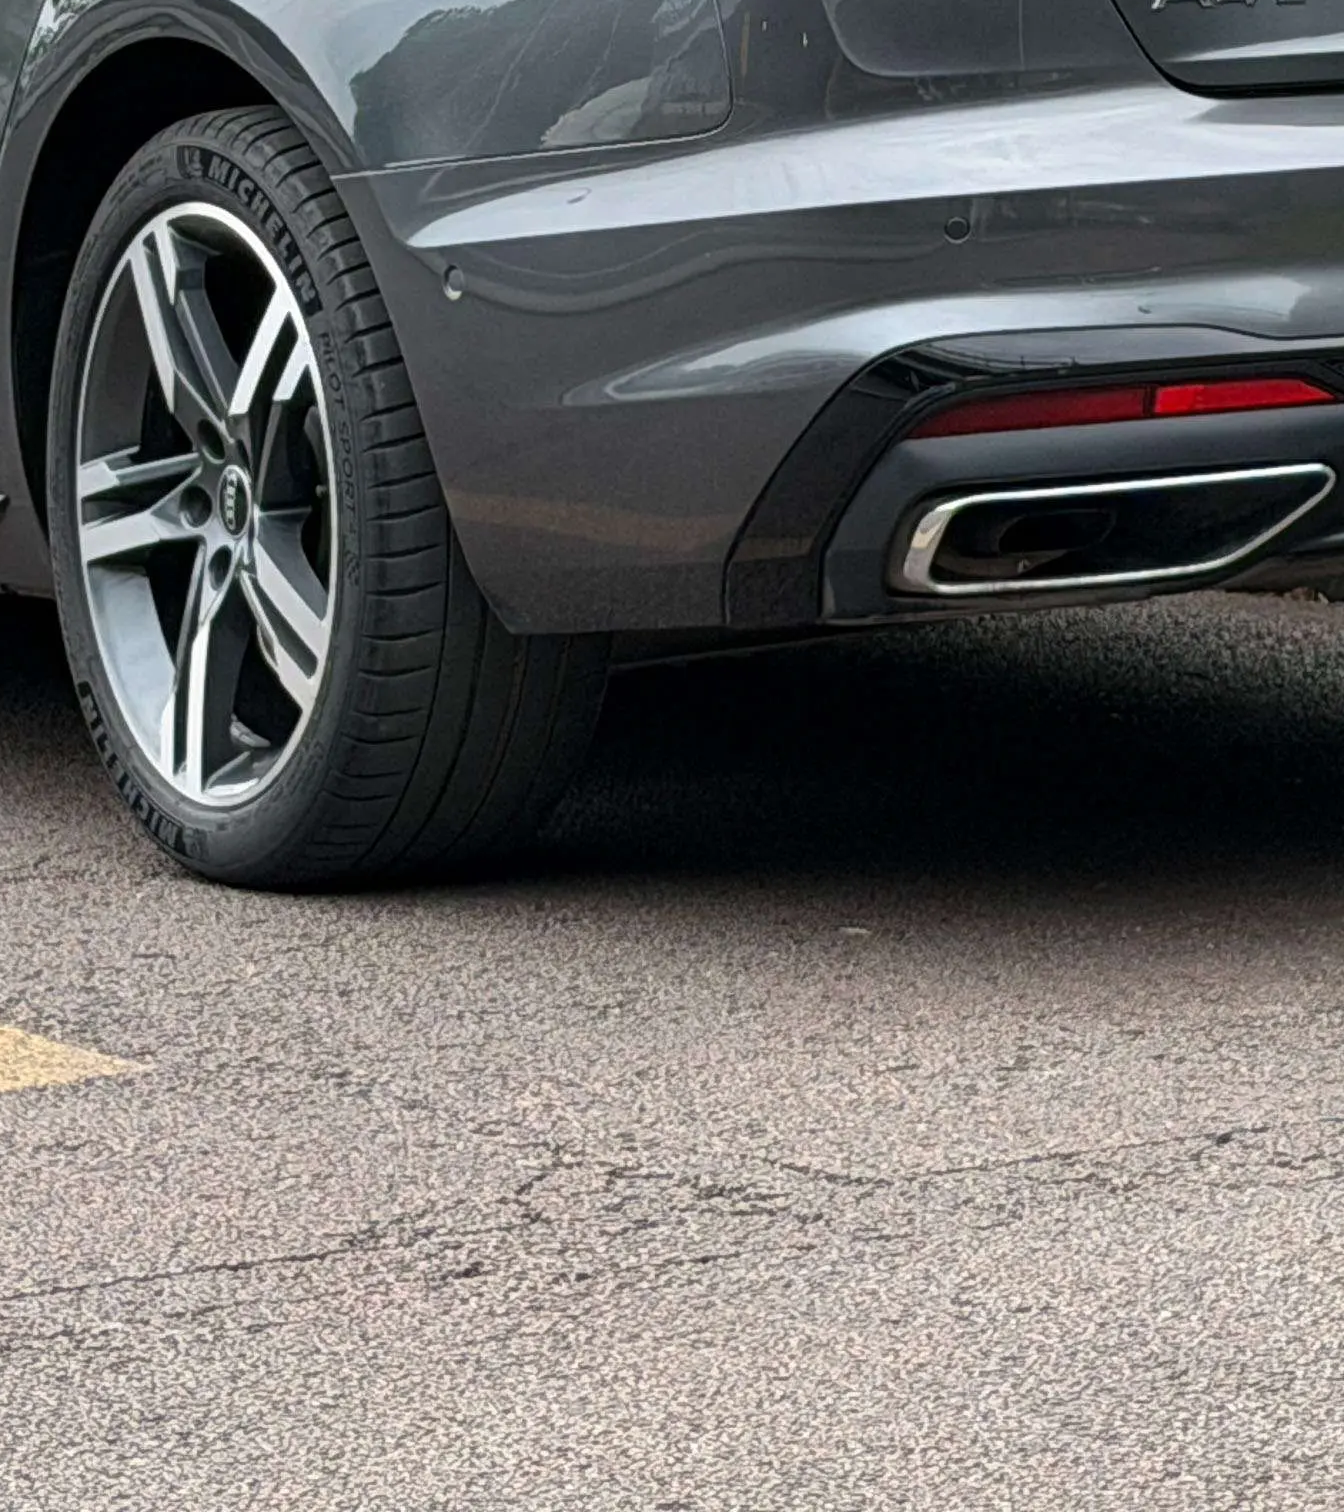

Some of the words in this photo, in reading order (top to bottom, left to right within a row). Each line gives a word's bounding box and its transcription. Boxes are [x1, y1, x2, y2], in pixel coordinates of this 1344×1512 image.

[207, 154, 320, 304] MICHELIN
[319, 330, 346, 406] PILOT
[338, 421, 356, 512] SPORT
